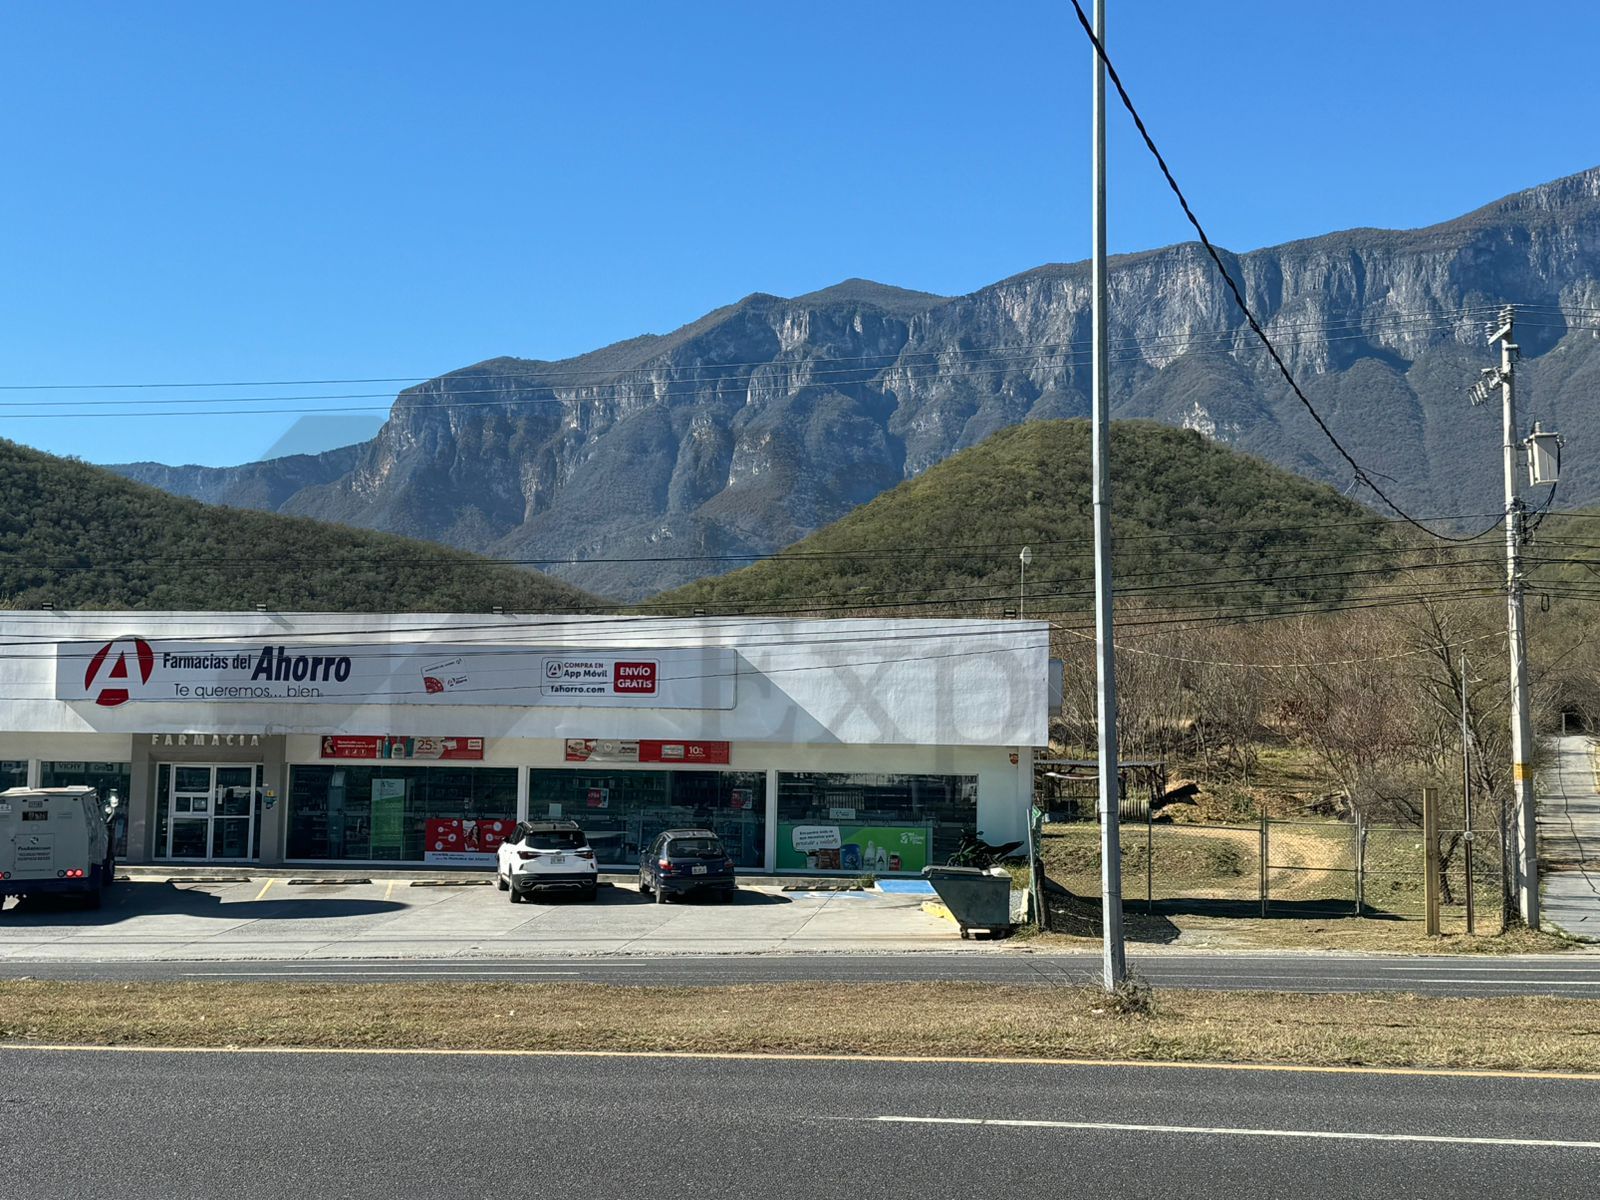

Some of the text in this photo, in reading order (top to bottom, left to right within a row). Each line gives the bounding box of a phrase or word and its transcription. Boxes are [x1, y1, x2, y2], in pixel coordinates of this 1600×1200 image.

[163, 646, 352, 682] Farmacias del Ahorro
[564, 669, 608, 679] App Móvil
[620, 666, 651, 676] ENVÍO
[551, 685, 606, 693] fahorro.com
[617, 680, 653, 688] GRATIS
[174, 683, 190, 697] Te
[194, 686, 282, 699] queremos...
[151, 734, 260, 746] FARMACIA
